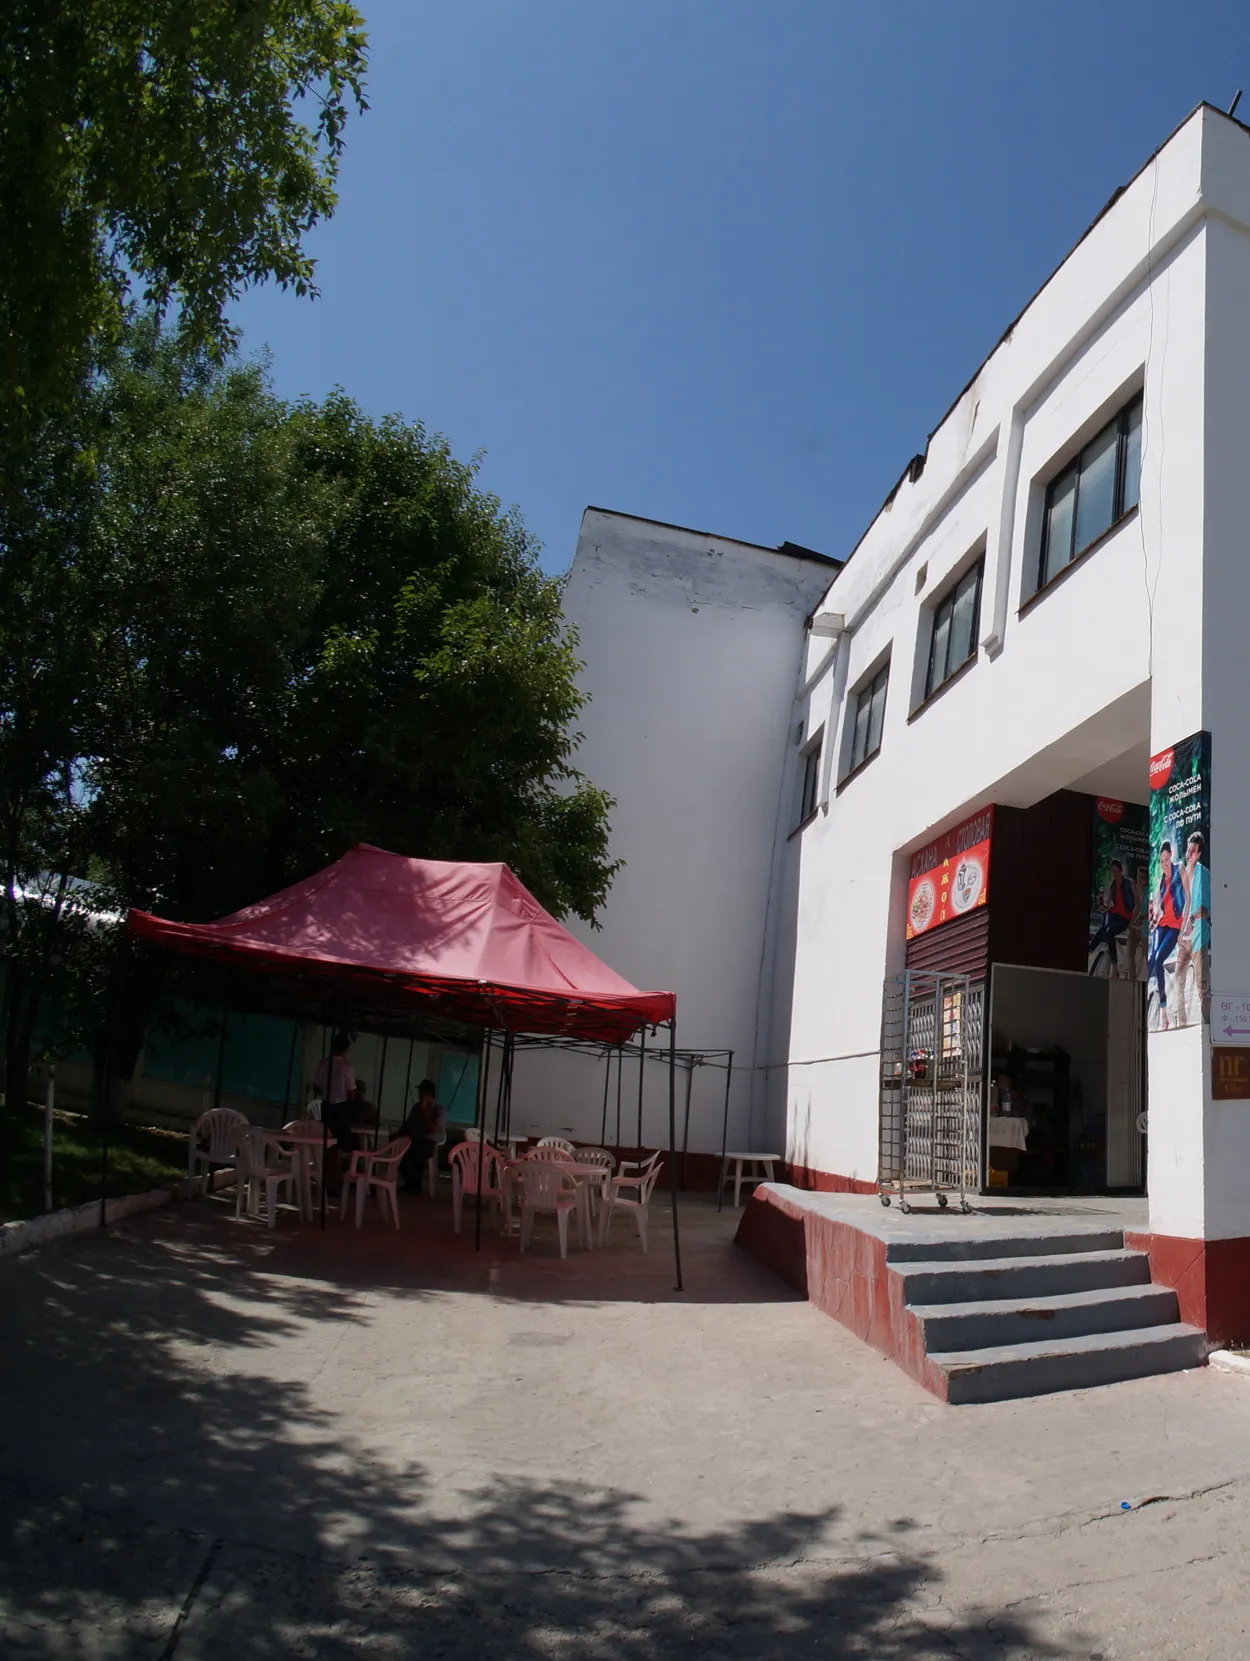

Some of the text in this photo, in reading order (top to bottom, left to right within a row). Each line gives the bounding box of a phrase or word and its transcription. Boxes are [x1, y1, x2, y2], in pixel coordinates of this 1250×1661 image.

[1168, 773, 1202, 794] COCA-COLA
[1168, 783, 1202, 804] ЖОЛЫМЕН
[1168, 801, 1202, 822] COCA-COLA
[1175, 811, 1202, 829] ПО ПУТИ
[957, 812, 990, 853] СТОЛОВАЯ
[910, 845, 937, 879] АСХАНА
